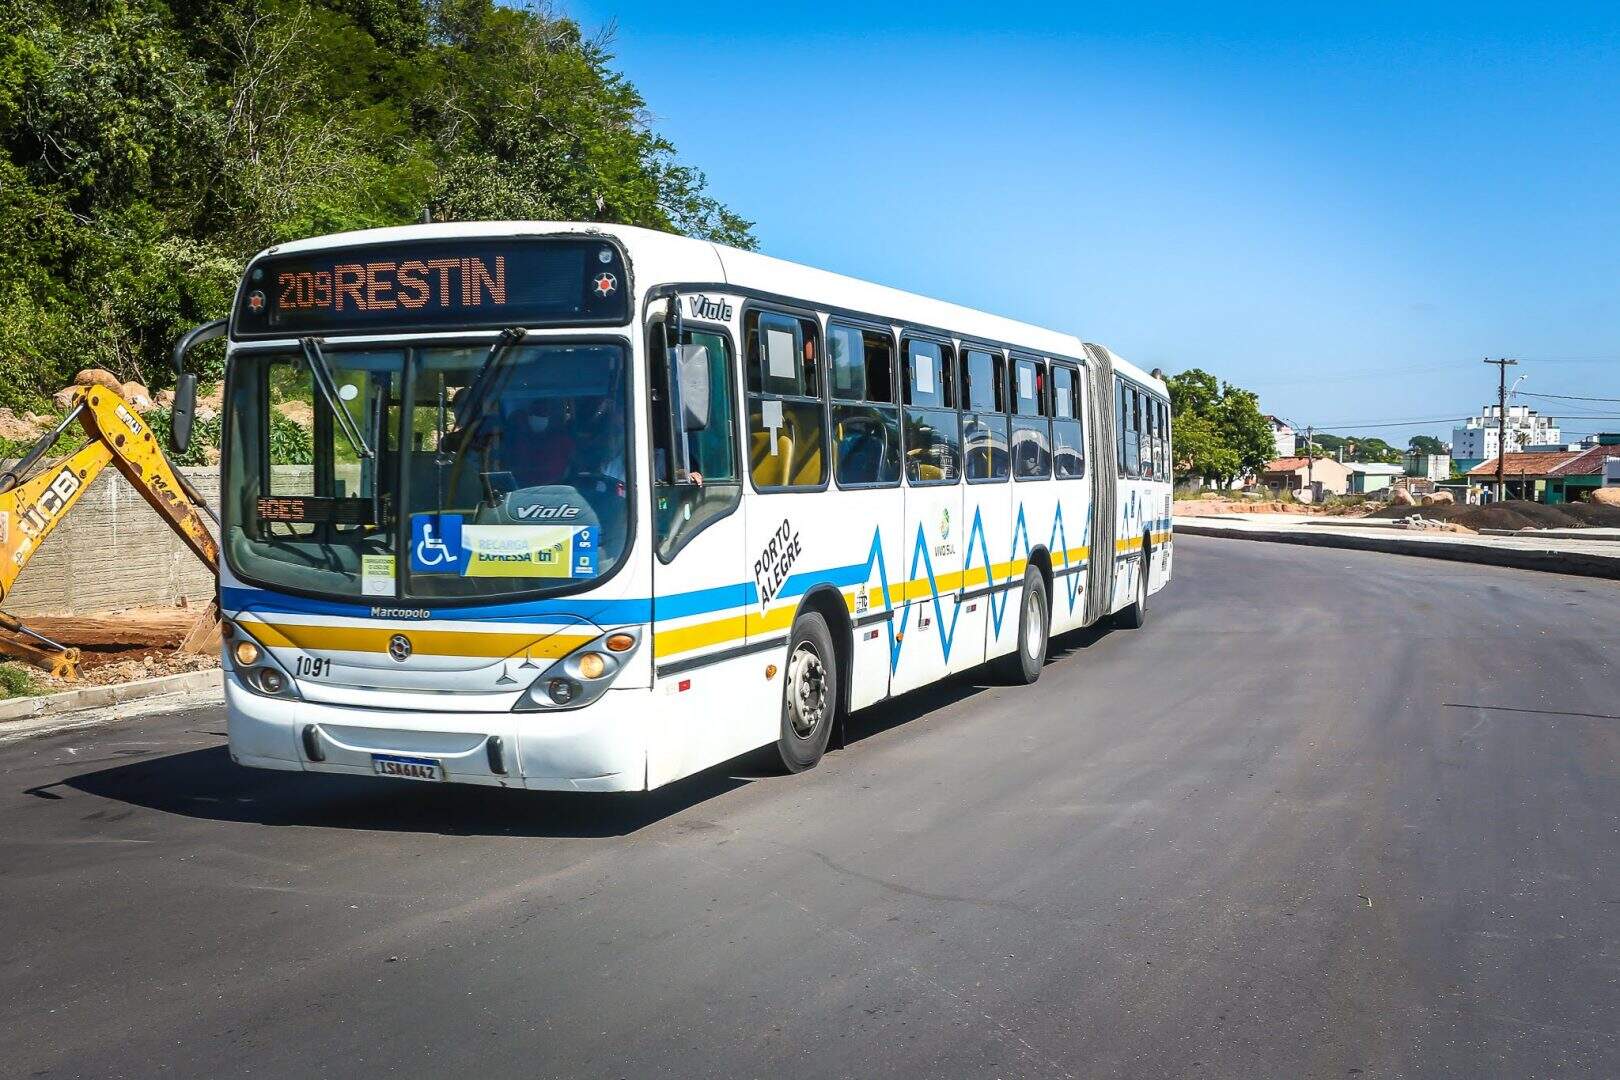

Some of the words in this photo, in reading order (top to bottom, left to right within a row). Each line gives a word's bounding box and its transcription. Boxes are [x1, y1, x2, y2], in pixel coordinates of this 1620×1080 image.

[278, 271, 332, 309] 209
[334, 256, 507, 311] RESTIN
[689, 293, 733, 320] Viale
[19, 472, 81, 540] JCB
[518, 503, 580, 520] Viale
[479, 538, 529, 550] RECARGA
[538, 549, 552, 562] tri
[754, 518, 791, 583] PORTO
[764, 532, 802, 607] ALEGRE
[370, 606, 430, 618] Marcopolo
[296, 655, 331, 678] 1091
